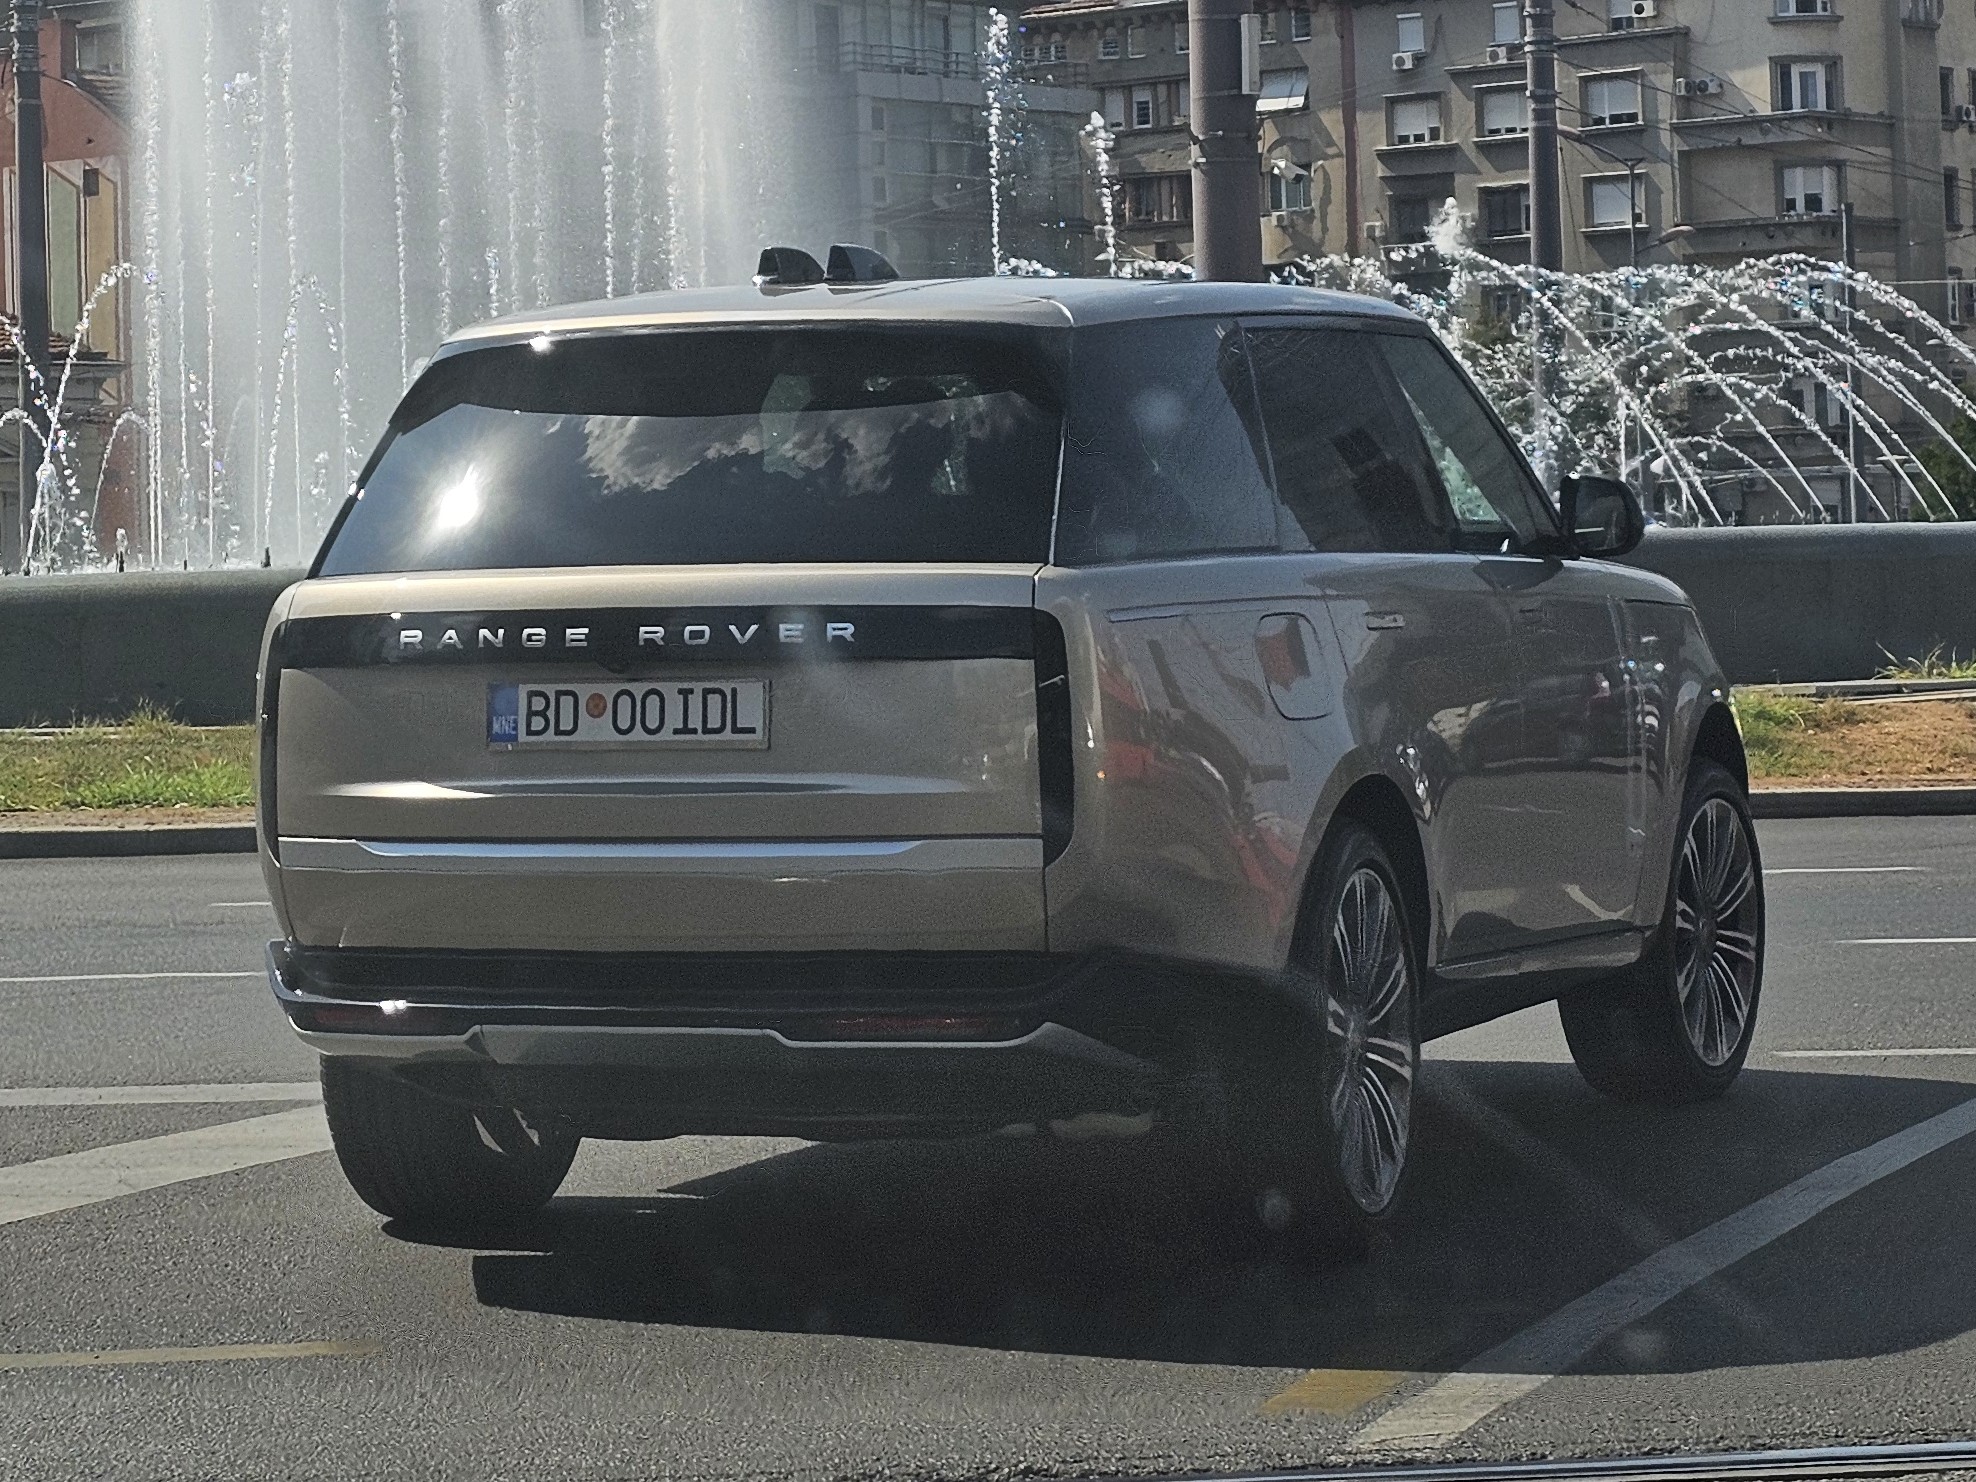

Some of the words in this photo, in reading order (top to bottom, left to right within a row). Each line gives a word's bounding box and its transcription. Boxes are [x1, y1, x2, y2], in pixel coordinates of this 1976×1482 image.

[399, 627, 590, 650] RANGE
[638, 622, 856, 645] ROVER
[525, 689, 580, 737] BD
